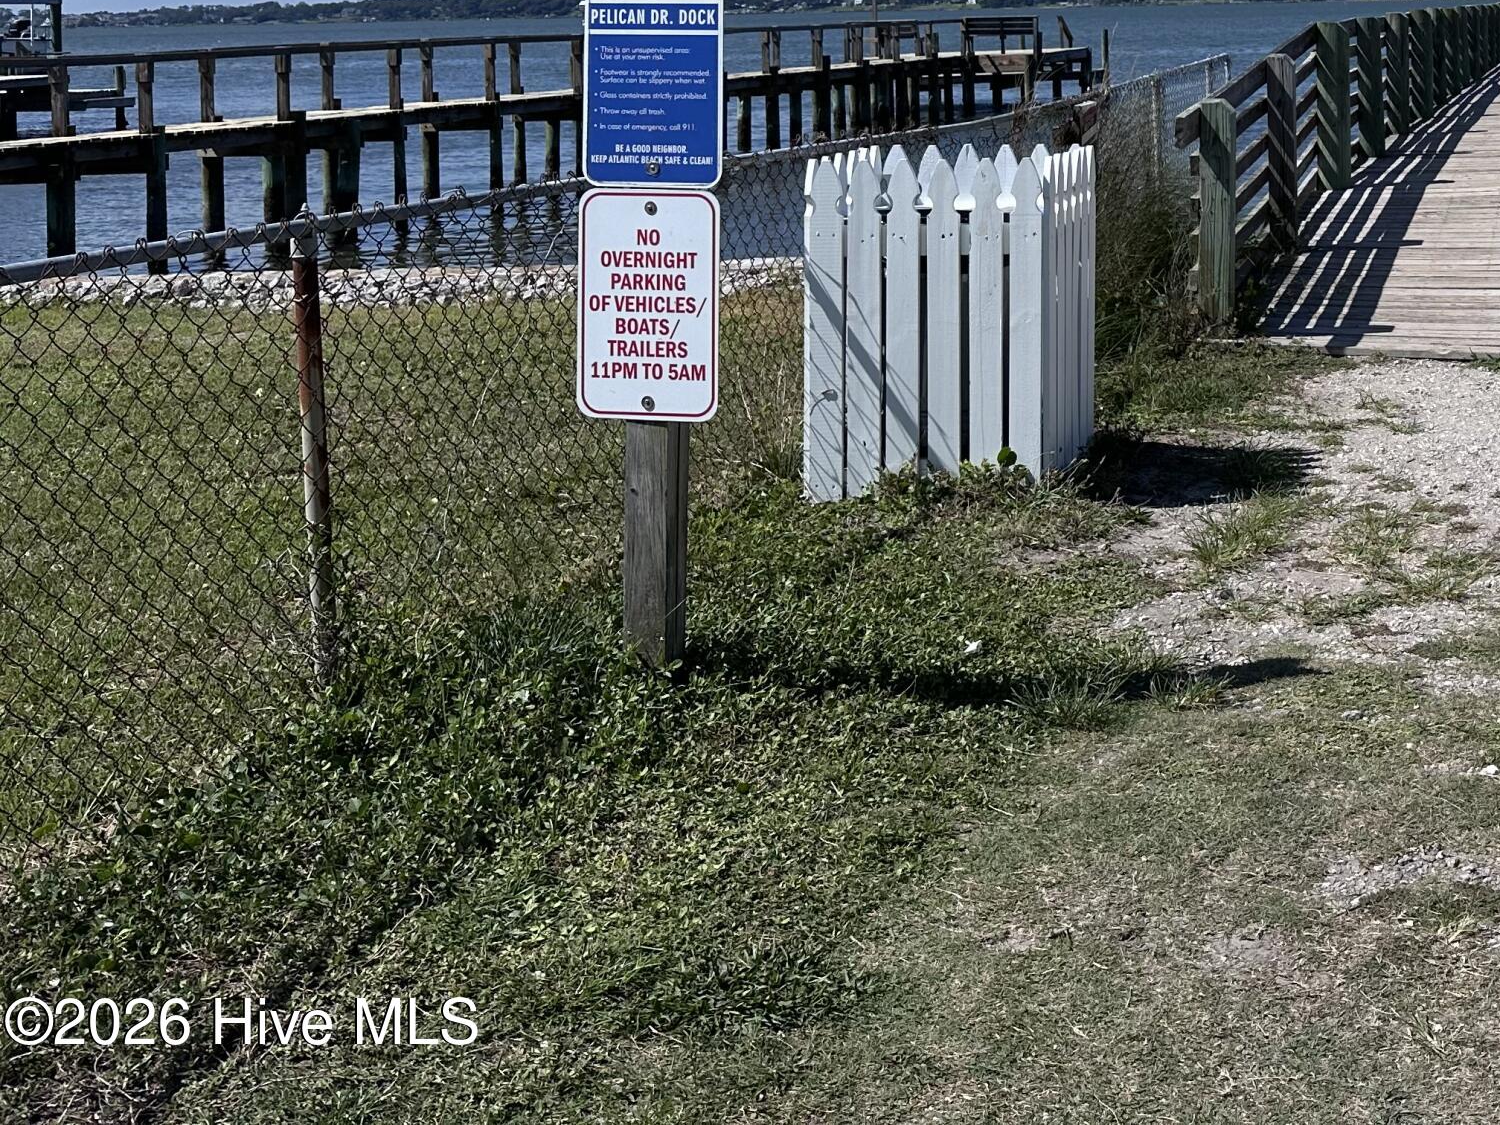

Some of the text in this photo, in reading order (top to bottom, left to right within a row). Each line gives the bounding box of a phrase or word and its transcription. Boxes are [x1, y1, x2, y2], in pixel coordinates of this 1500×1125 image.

[591, 9, 716, 25] PELICAN DR. DOCK
[632, 47, 673, 55] unsupervised
[600, 68, 629, 76] Footwear
[636, 69, 661, 78] strongly
[600, 76, 625, 84] Surface
[649, 77, 673, 85] slippery
[600, 91, 617, 99] Glass
[652, 92, 672, 100] strictly
[615, 144, 688, 154] BE A GOOD NEIGHBOR.
[591, 155, 714, 165] KEEP ATLANTIC BEACH SAFE & CLEAN!
[637, 229, 660, 246] NO
[601, 251, 697, 269] OVERNIGHT
[611, 273, 686, 291] PARKING
[589, 295, 707, 318] OF VEHICLES/
[615, 318, 680, 339] BOATS/
[608, 340, 688, 358] TRAILERS
[591, 362, 707, 381] 11PM TO 5AM
